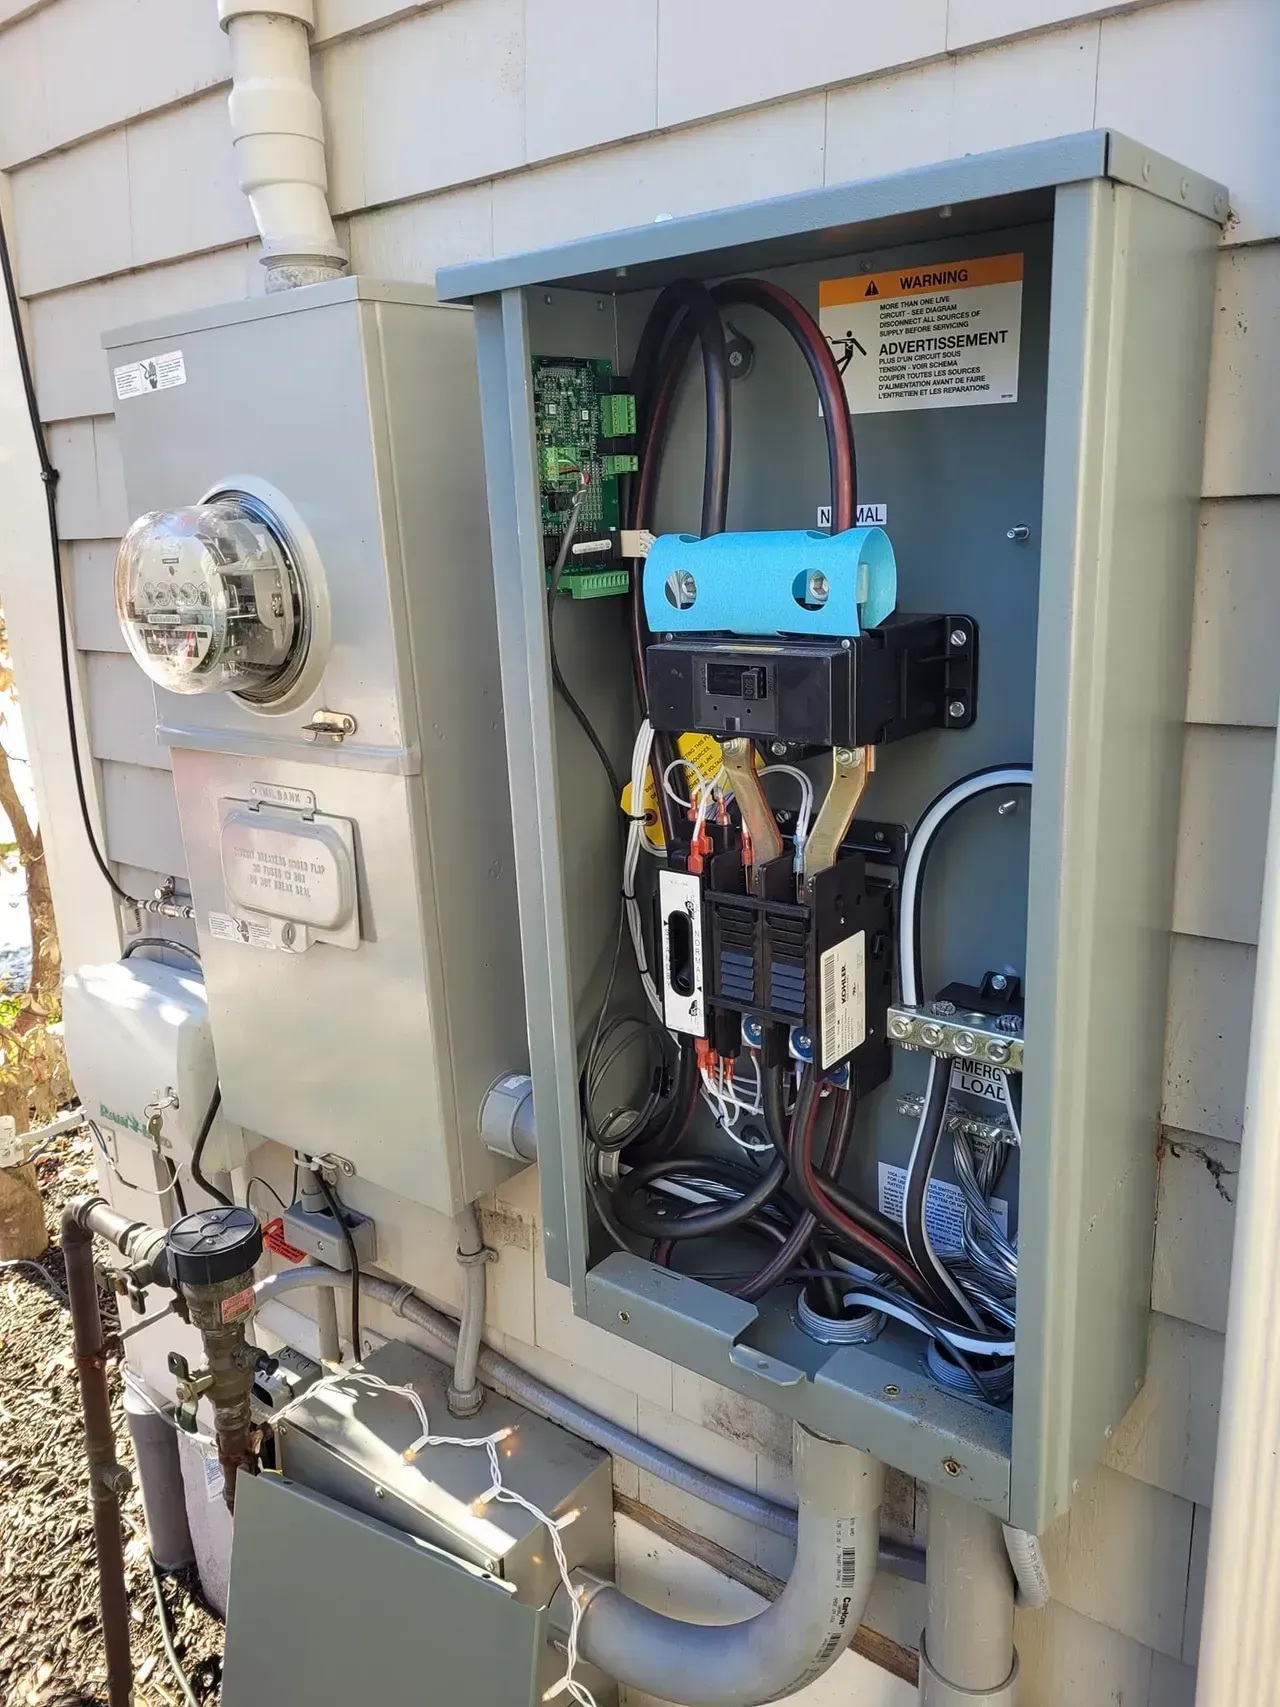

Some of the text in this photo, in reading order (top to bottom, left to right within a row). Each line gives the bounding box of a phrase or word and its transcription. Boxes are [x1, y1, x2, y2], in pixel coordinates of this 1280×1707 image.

[900, 269, 968, 290] WARNING
[880, 302, 899, 310] MORE
[880, 310, 905, 319] CIRCUIT
[926, 304, 957, 313] DIAGRAM
[880, 317, 921, 328] DISCONNECT
[923, 315, 935, 323] ALL
[937, 312, 969, 321] SOURCES
[880, 321, 969, 337] SUPPLY BEFORE SERVICING
[880, 330, 1008, 355] ADVERTISSEMENT
[914, 353, 941, 361] CIRCUIT
[879, 365, 906, 373] TENSION
[929, 360, 958, 368] SCHEMA
[879, 373, 905, 381] COUPER
[907, 371, 932, 379] TOUTES
[948, 367, 981, 375] SOURCES
[879, 380, 931, 390] D'ALIMENTATION
[933, 378, 953, 386] AVANT
[966, 375, 986, 383] FAIRE
[878, 389, 918, 399] L'ENTRETIEN
[943, 384, 990, 393] REPARATIONS
[821, 507, 883, 523] NMAL
[261, 786, 301, 803] MILBANK
[100, 1104, 128, 1128] RAIN
[839, 1597, 851, 1625] Carlon
